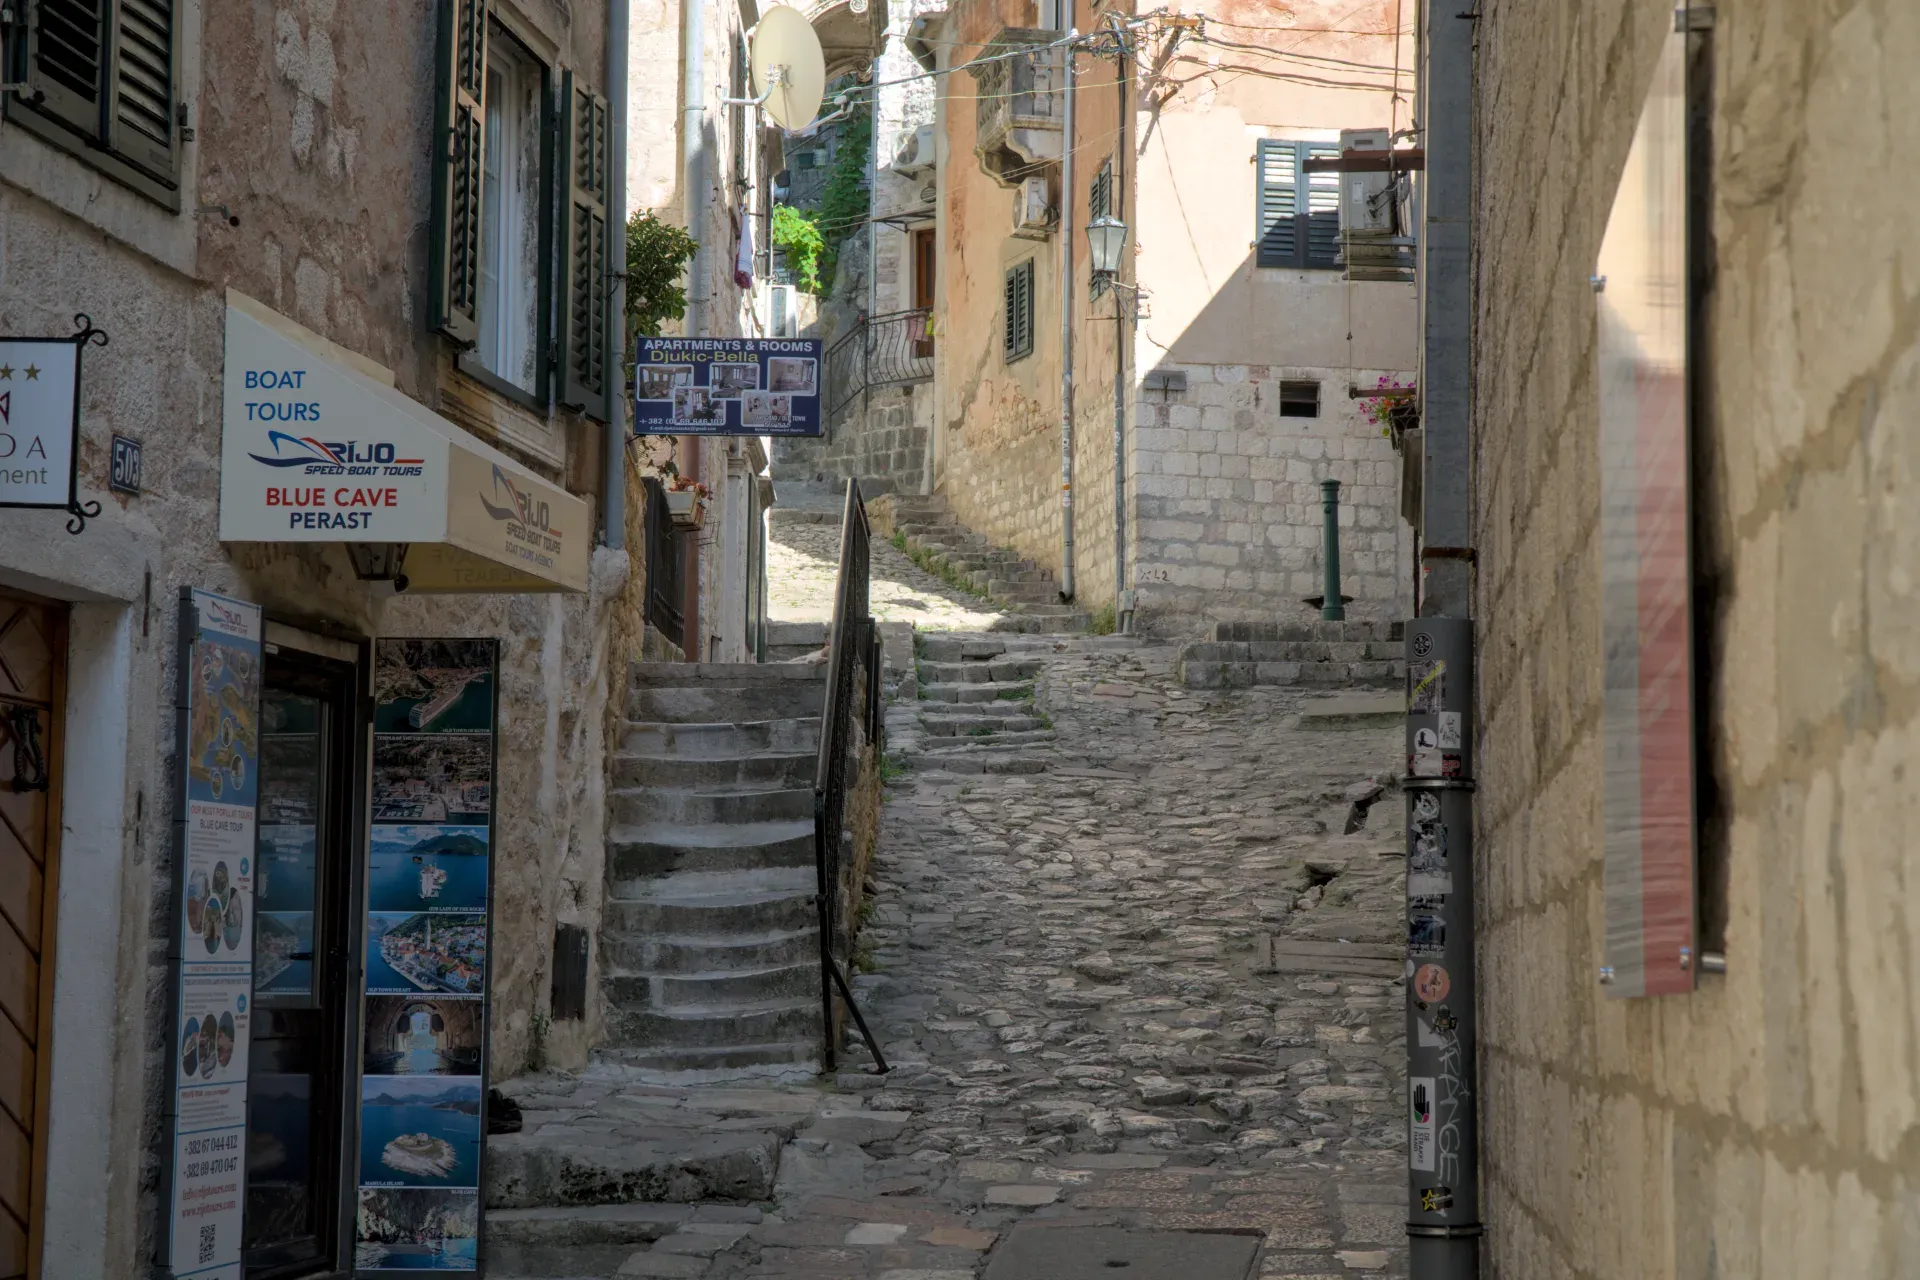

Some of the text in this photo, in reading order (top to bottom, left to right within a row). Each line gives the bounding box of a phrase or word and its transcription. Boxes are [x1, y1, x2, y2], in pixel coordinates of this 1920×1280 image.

[644, 340, 813, 352] APARTMENTS & ROOMS
[651, 351, 758, 364] Djukic-Bella
[245, 371, 306, 388] BOAT
[245, 403, 321, 421] TOURS
[115, 444, 140, 487] 503
[304, 466, 423, 476] SPEED BOAT TOURS
[266, 487, 398, 507] BLUE CAVE
[290, 512, 373, 529] PERAST
[507, 522, 561, 555] SPEED BOAT TOURS
[506, 541, 518, 555] BOAT
[191, 805, 201, 815] OUR
[238, 810, 253, 821] TOURS
[200, 819, 244, 832] BLUE CAVE TOUR
[184, 1134, 238, 1156] +382 67 044 412
[1423, 1132, 1430, 1143] DE
[183, 1156, 238, 1179] +382 69 470 047
